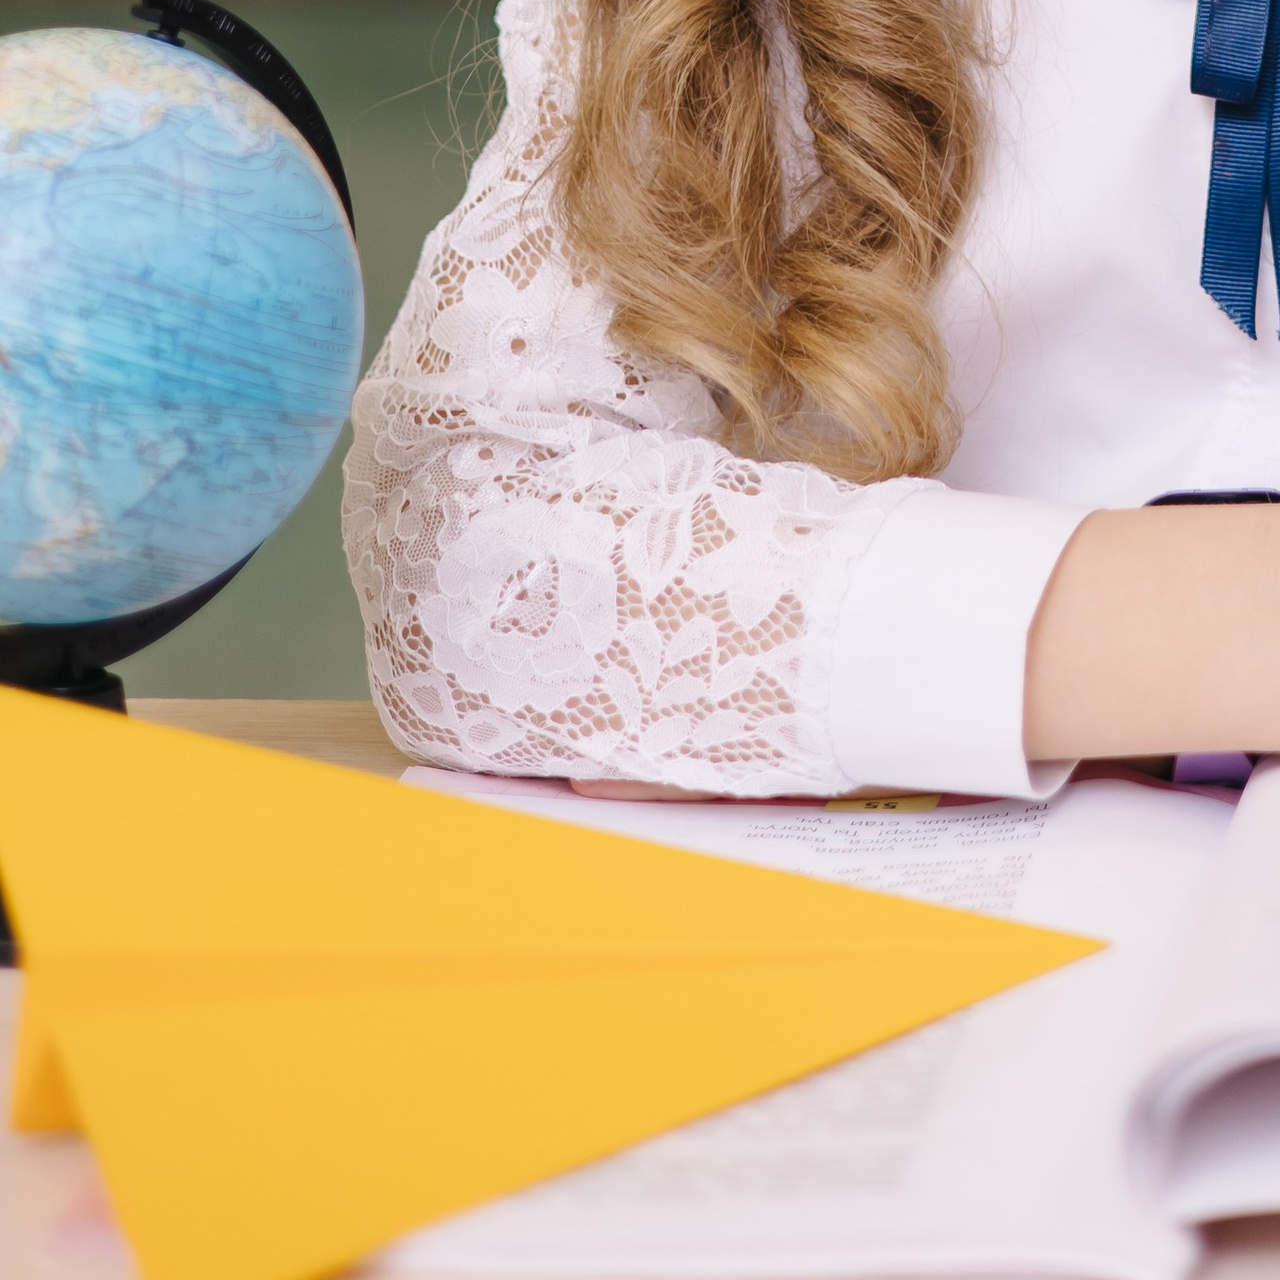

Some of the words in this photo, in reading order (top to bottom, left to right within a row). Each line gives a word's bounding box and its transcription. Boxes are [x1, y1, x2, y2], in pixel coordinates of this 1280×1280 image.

[1025, 803, 1051, 813] Ты
[915, 812, 1009, 825] гоняешь
[953, 827, 1015, 838] ветру
